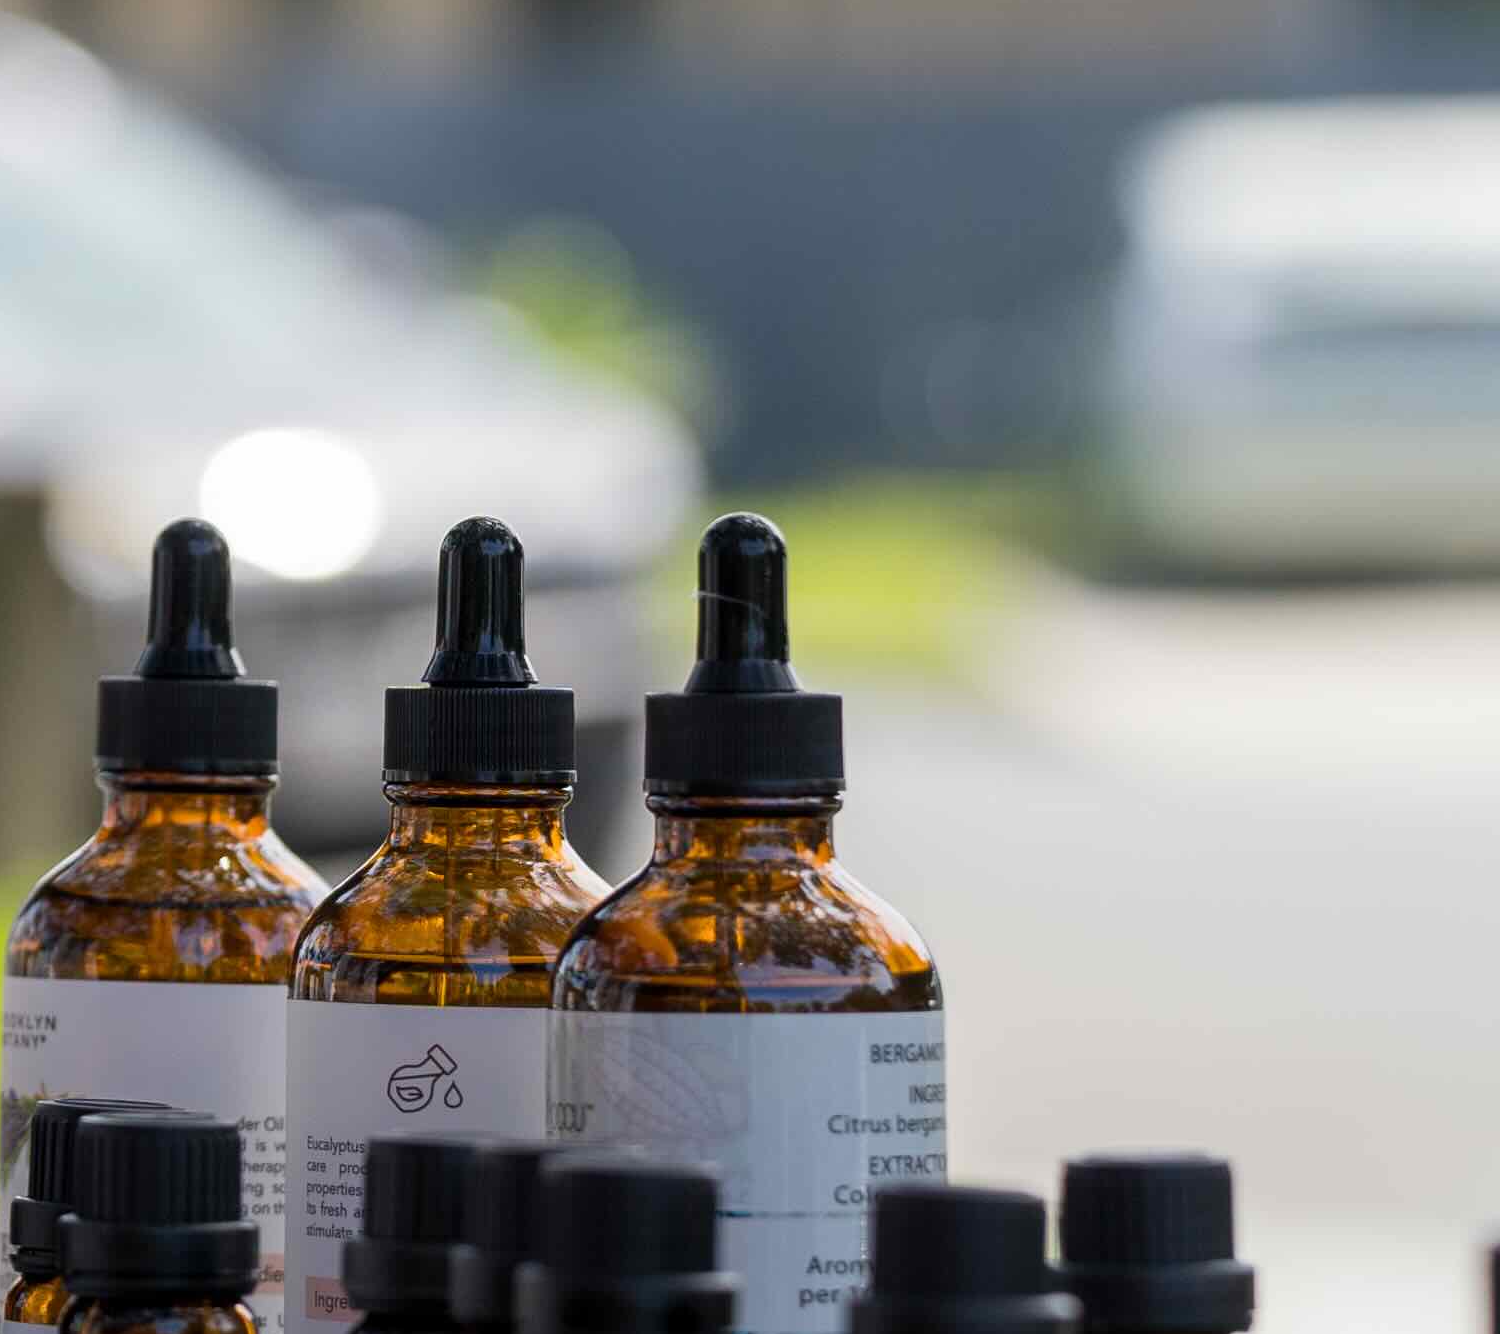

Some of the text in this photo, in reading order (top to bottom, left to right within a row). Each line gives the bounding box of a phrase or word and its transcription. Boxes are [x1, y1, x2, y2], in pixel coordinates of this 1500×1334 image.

[827, 1114, 892, 1135] Citrus
[307, 1135, 366, 1156] Eucalyptus
[306, 1160, 327, 1173] care
[306, 1181, 364, 1197] properties
[252, 1205, 271, 1216] on
[320, 1200, 348, 1218] fresh
[798, 1288, 841, 1308] per
